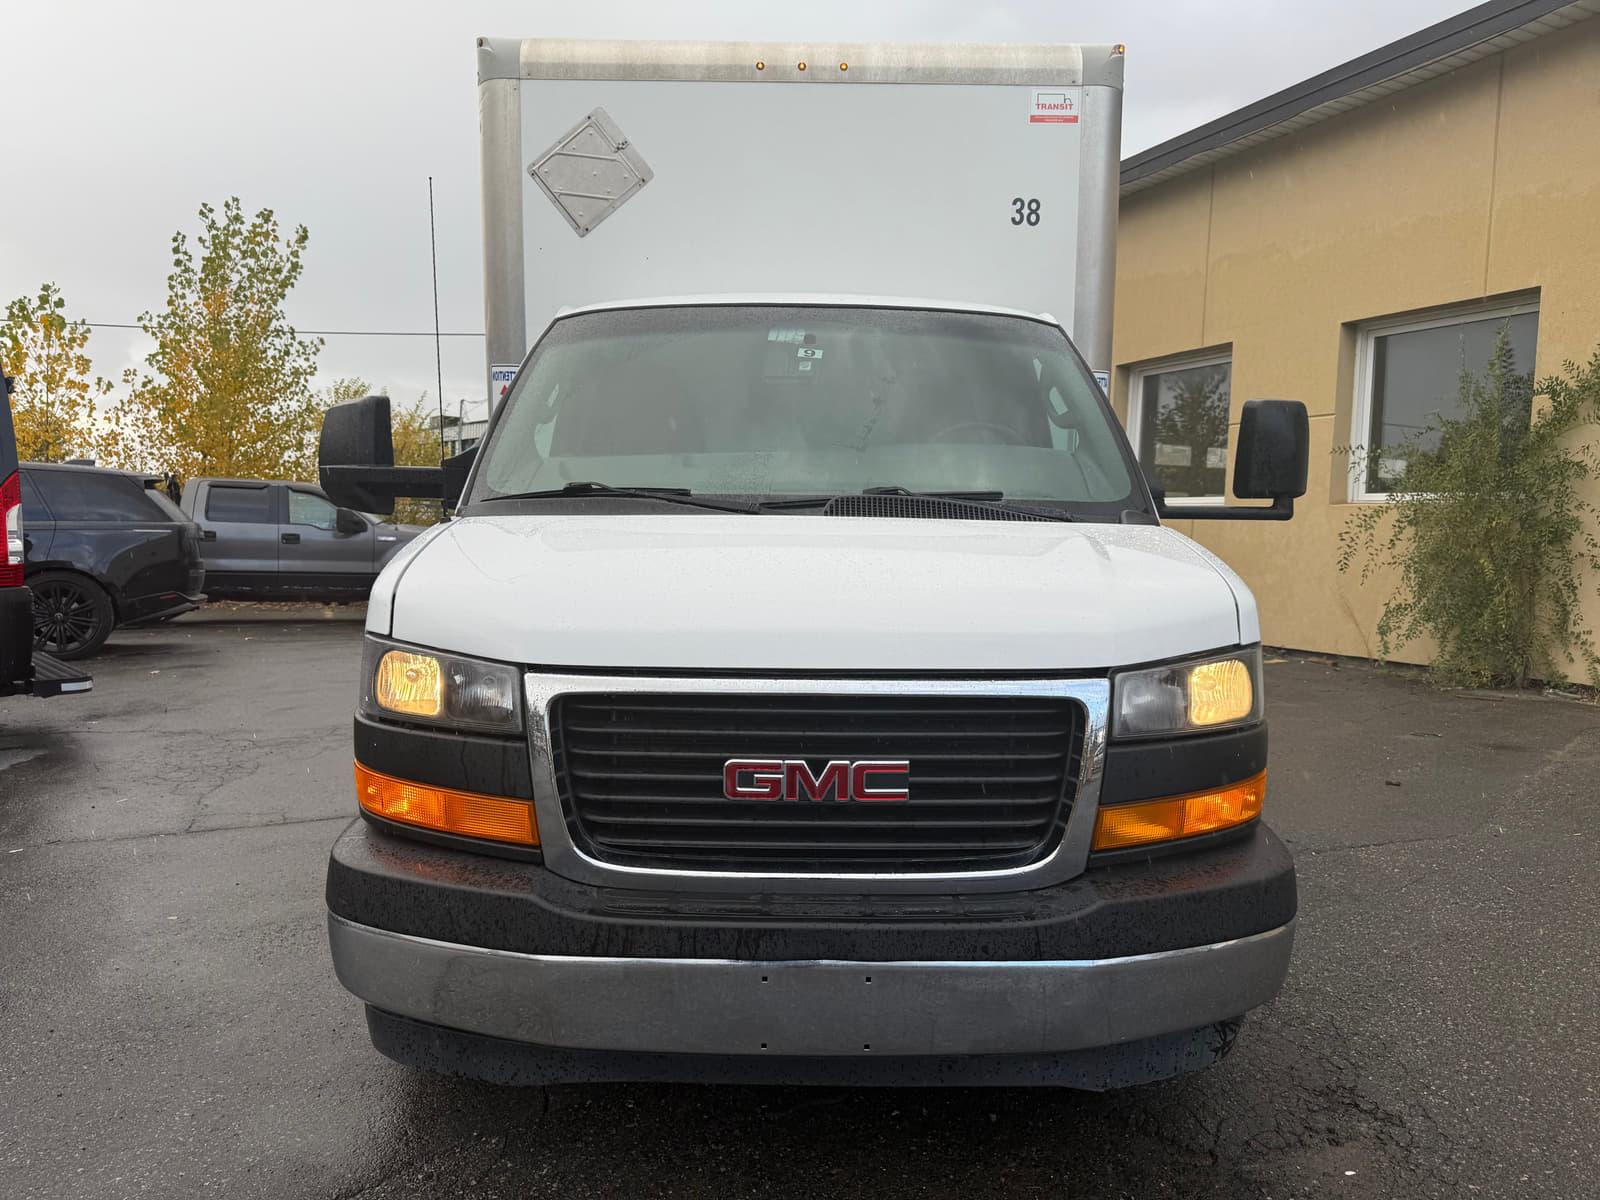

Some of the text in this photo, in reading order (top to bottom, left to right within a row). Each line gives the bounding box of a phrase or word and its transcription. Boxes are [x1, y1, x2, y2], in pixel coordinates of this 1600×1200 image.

[1035, 103, 1074, 111] TRANSIT
[1011, 197, 1041, 227] 38
[723, 758, 910, 802] GMC
